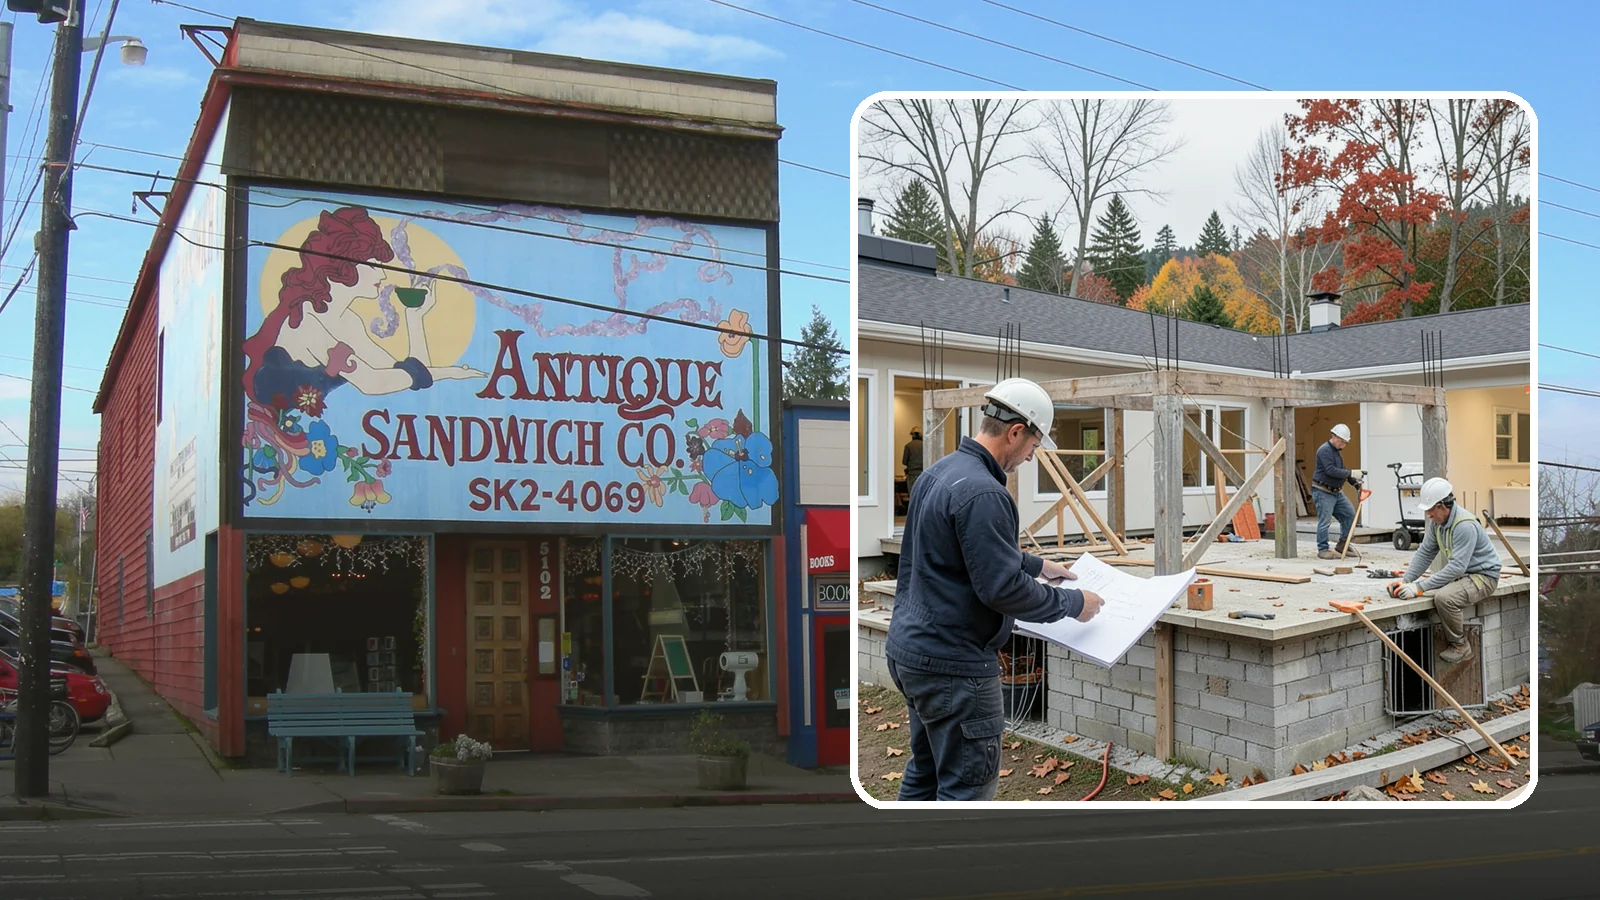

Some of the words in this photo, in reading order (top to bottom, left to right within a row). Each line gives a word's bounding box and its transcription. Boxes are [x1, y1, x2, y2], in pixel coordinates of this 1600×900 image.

[476, 329, 724, 421] ANTIQUE
[360, 409, 605, 468] SANDWICH
[617, 422, 686, 469] CO.
[468, 477, 646, 514] SK2-4069
[540, 542, 555, 600] 5102
[809, 556, 834, 569] BOOKS
